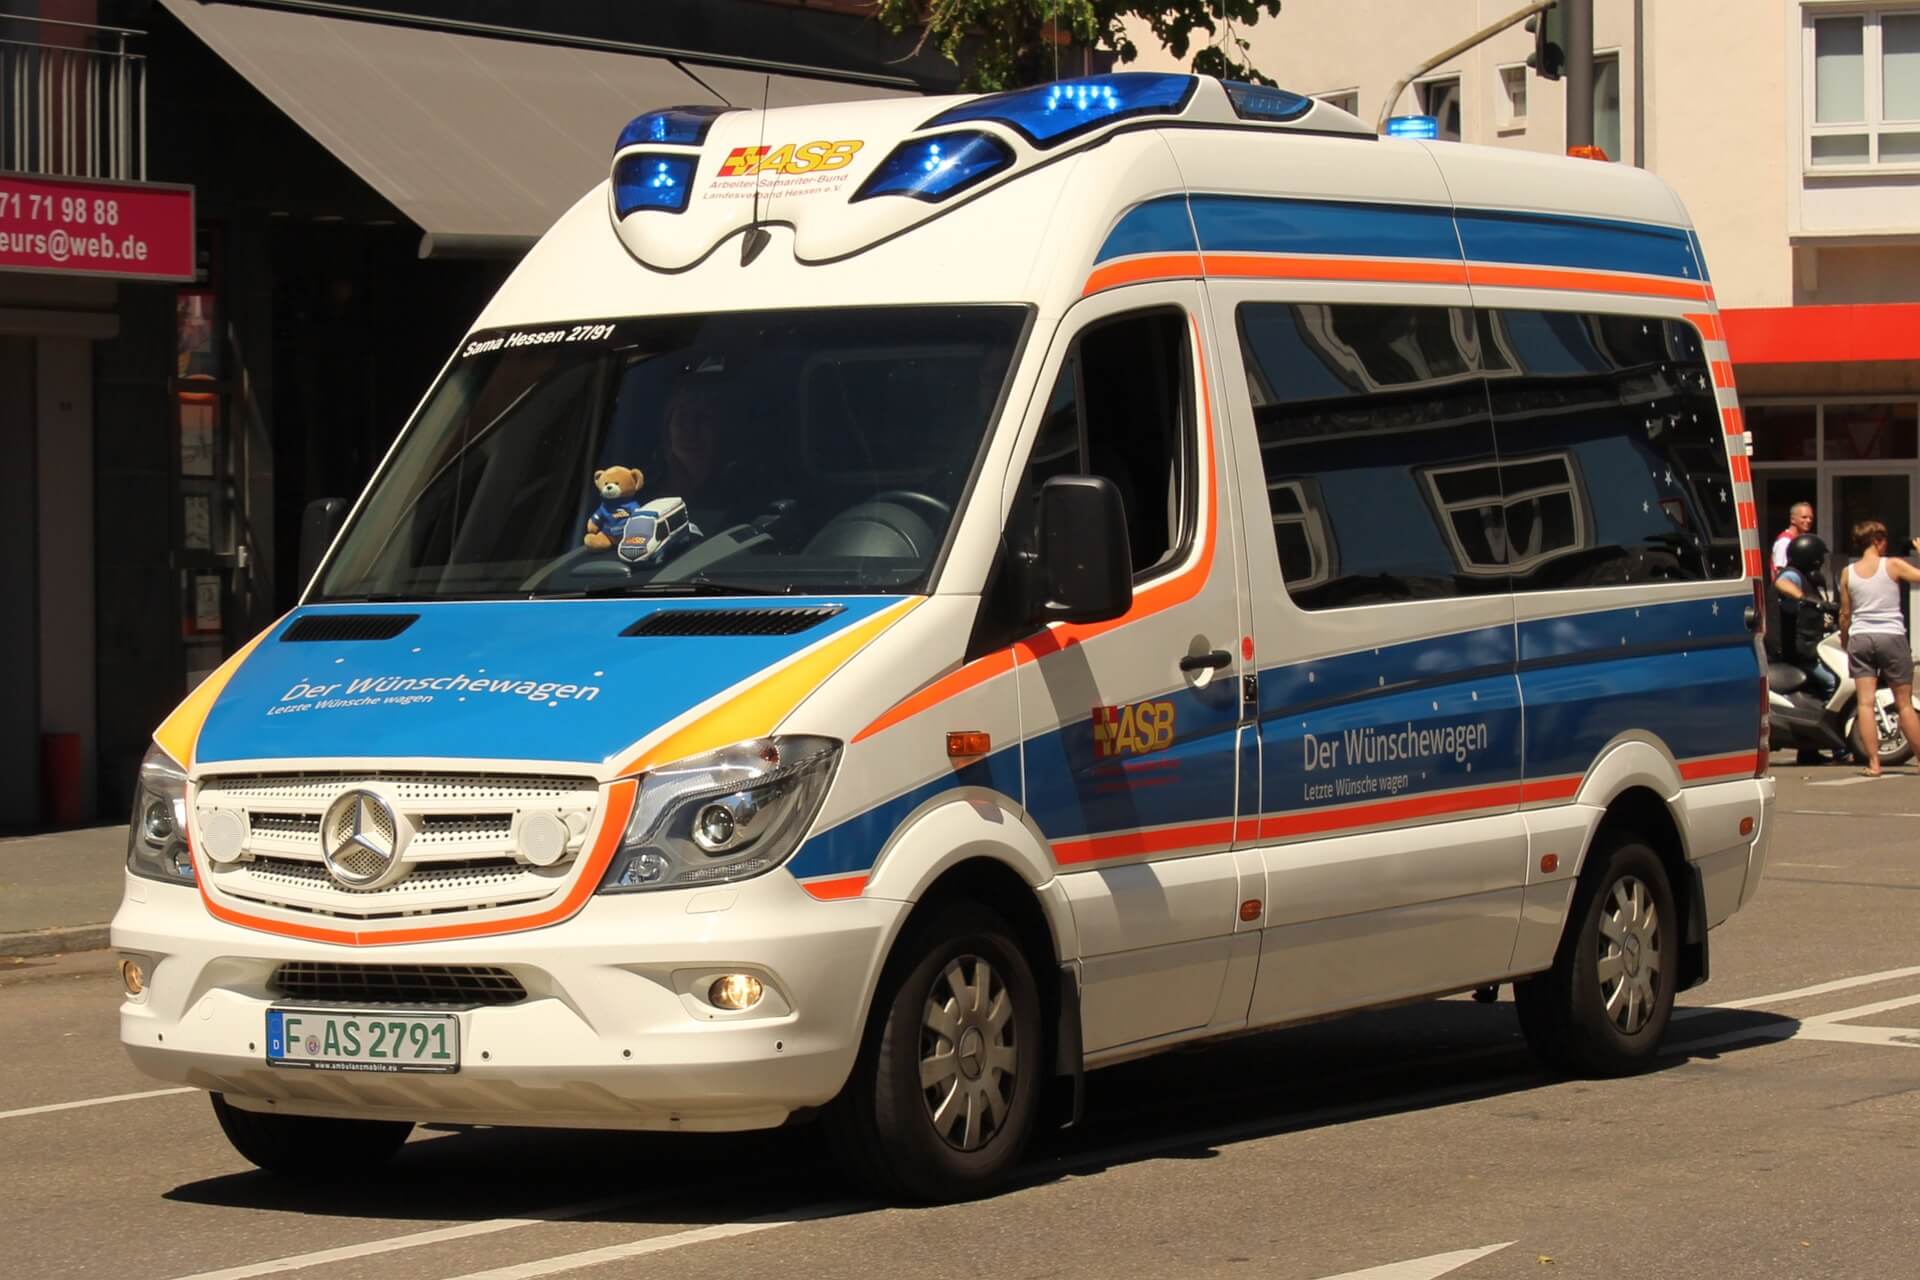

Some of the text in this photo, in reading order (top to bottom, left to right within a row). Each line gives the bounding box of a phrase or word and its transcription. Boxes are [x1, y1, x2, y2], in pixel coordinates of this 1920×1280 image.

[743, 139, 865, 176] ASB
[708, 173, 849, 190] Arbeiter-Samariter-Bund
[784, 186, 822, 198] Hessen
[29, 194, 53, 221] 71
[61, 196, 88, 224] 98
[93, 199, 119, 226] 88
[462, 323, 617, 357] Sama Hessen 27/91
[280, 673, 601, 702] Der Wünschewagen
[266, 694, 435, 716] Letzte Wünsche wagen
[1114, 700, 1176, 755] ASB
[1304, 721, 1488, 772] Der Wünschewagen
[1304, 773, 1409, 801] Letzte Wünsche wagen
[273, 1039, 280, 1050] D
[286, 1018, 451, 1060] F AS 2791
